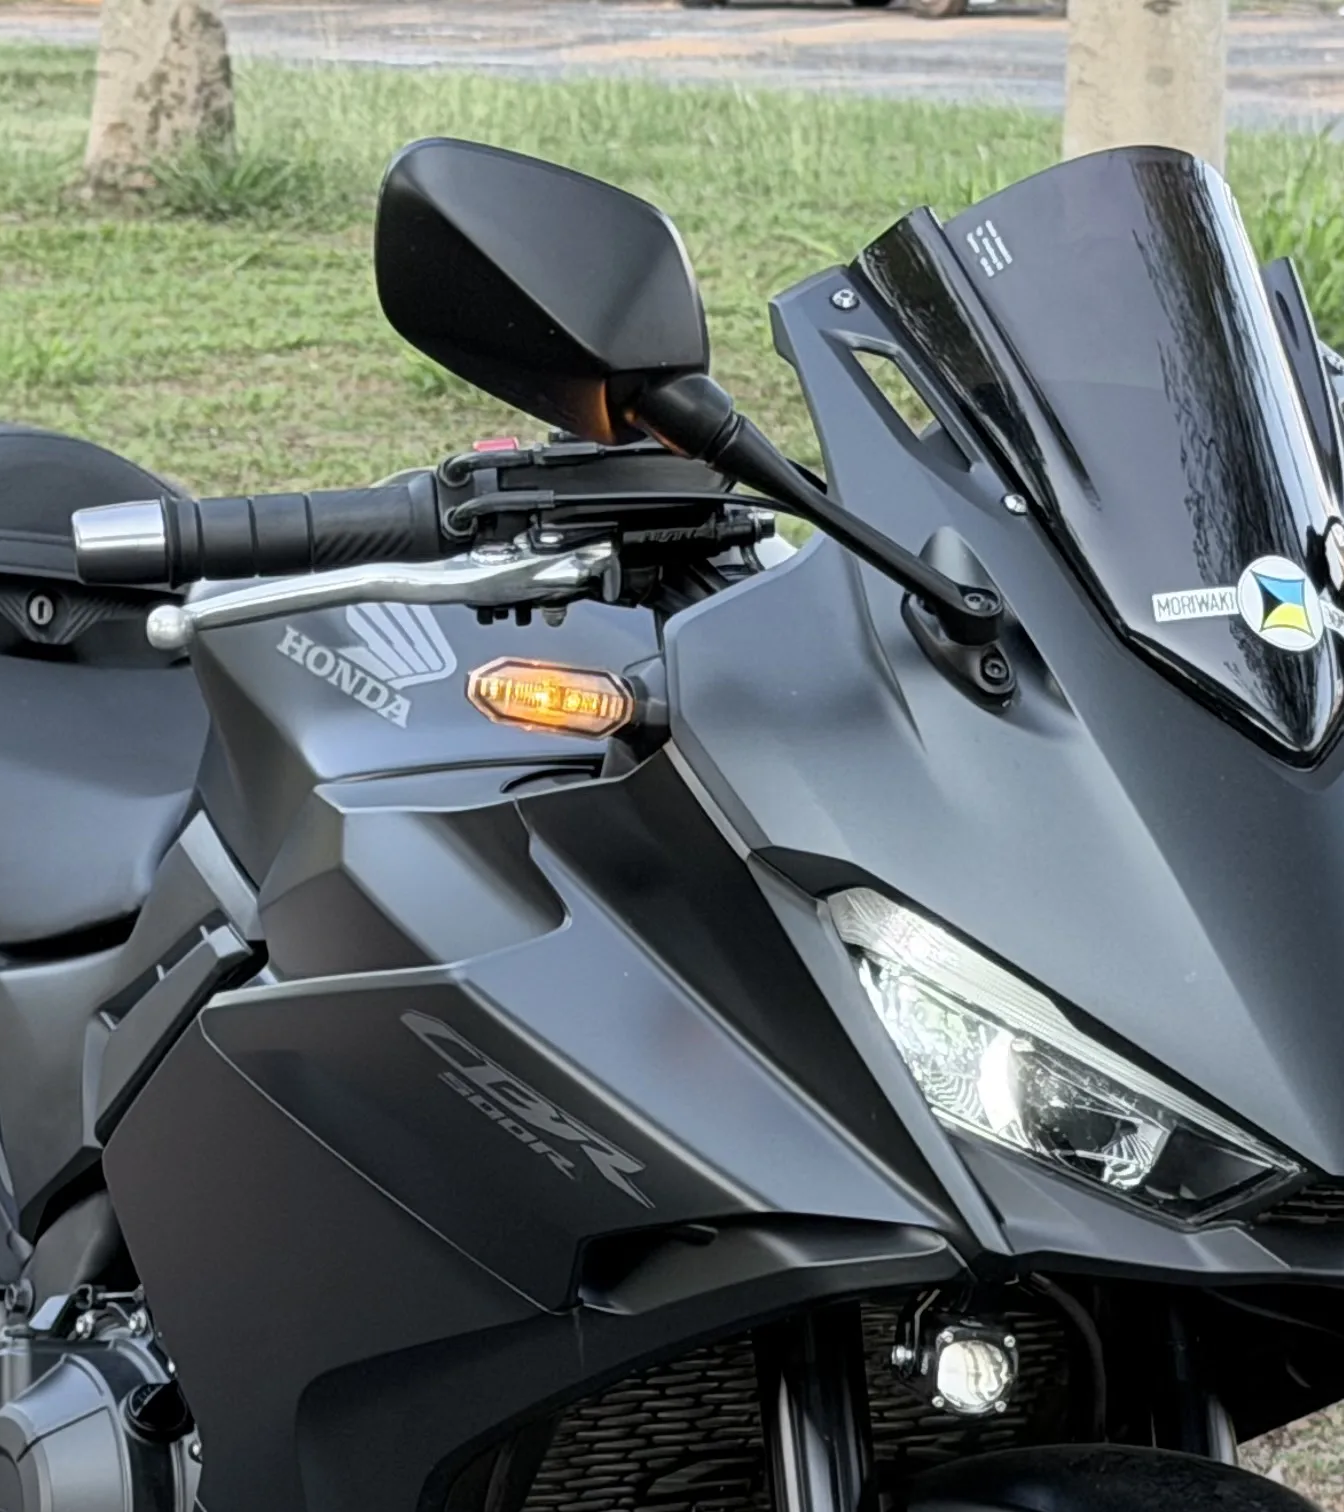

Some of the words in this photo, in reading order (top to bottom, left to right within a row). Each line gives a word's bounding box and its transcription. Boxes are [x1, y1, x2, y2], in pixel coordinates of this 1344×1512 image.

[1156, 590, 1234, 618] MORIWAKI
[276, 625, 412, 729] HONDA
[400, 1008, 656, 1209] CBR
